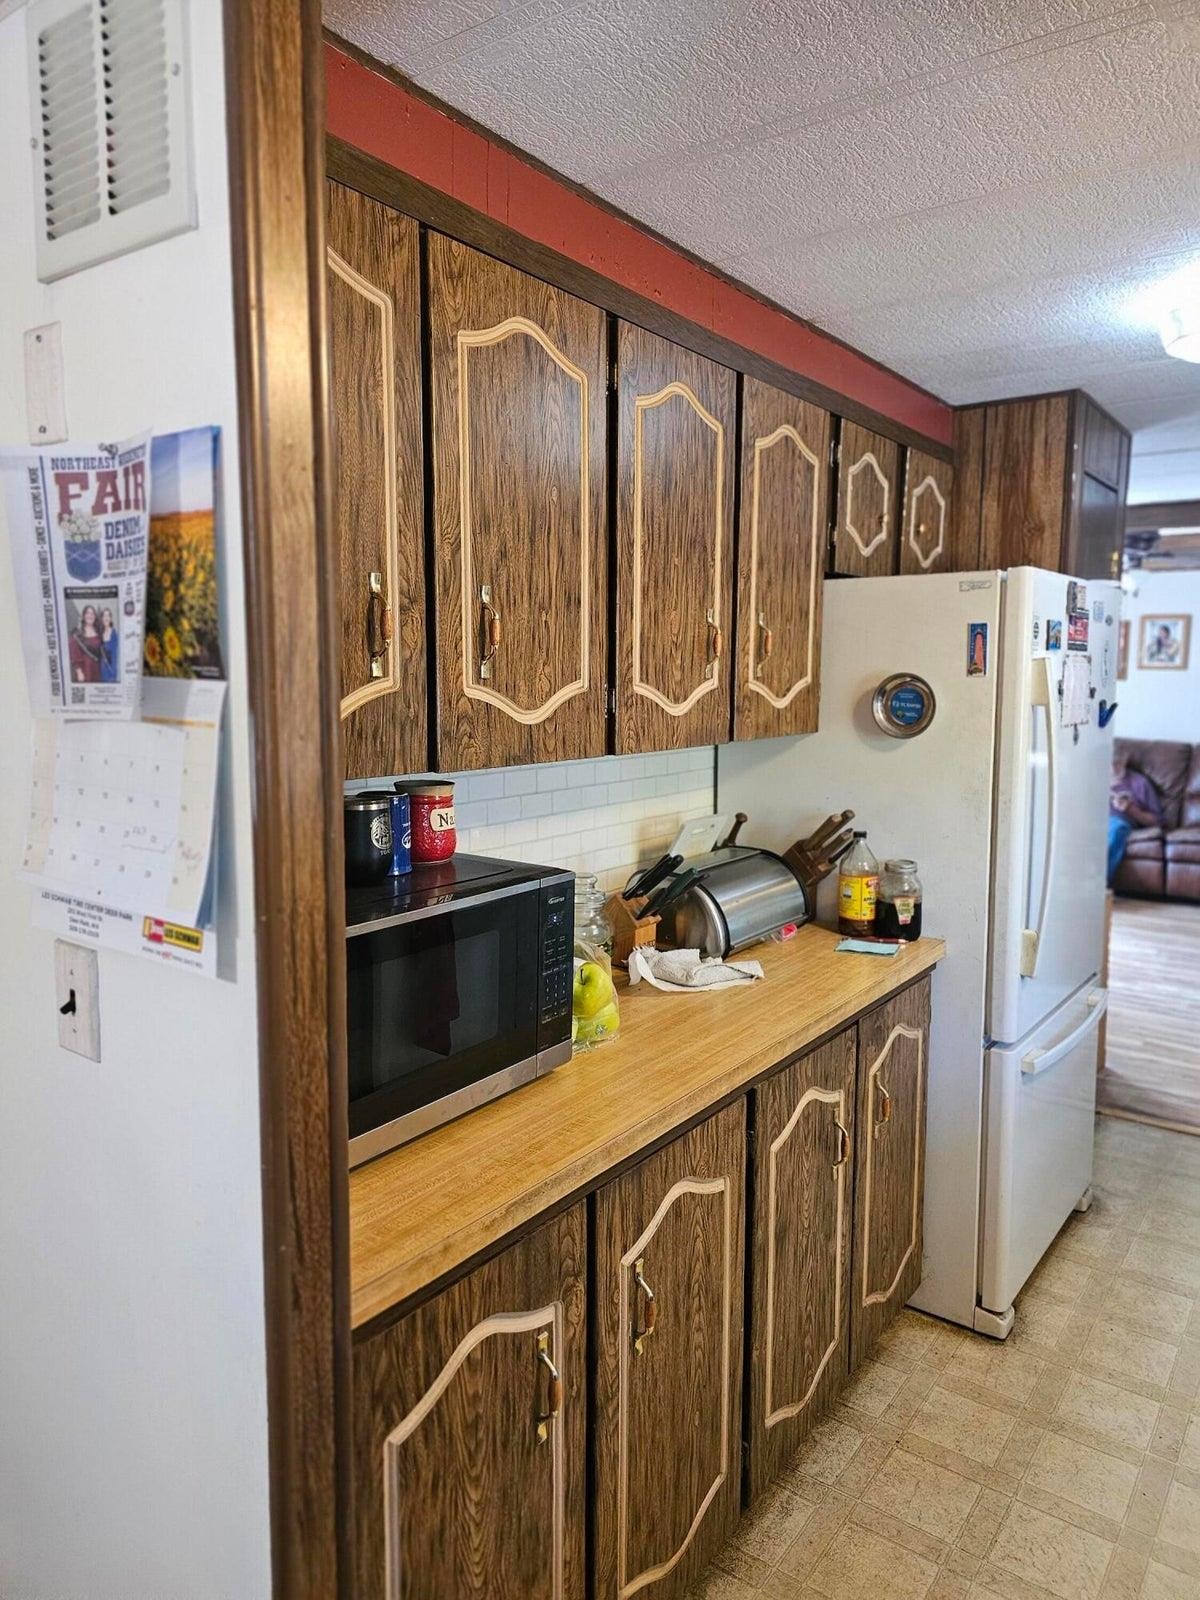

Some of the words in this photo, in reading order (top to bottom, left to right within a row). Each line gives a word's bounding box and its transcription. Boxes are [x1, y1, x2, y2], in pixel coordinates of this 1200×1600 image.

[51, 457, 116, 471] NORTHEAST
[54, 460, 146, 516] FAIR
[104, 516, 141, 540] DENIM
